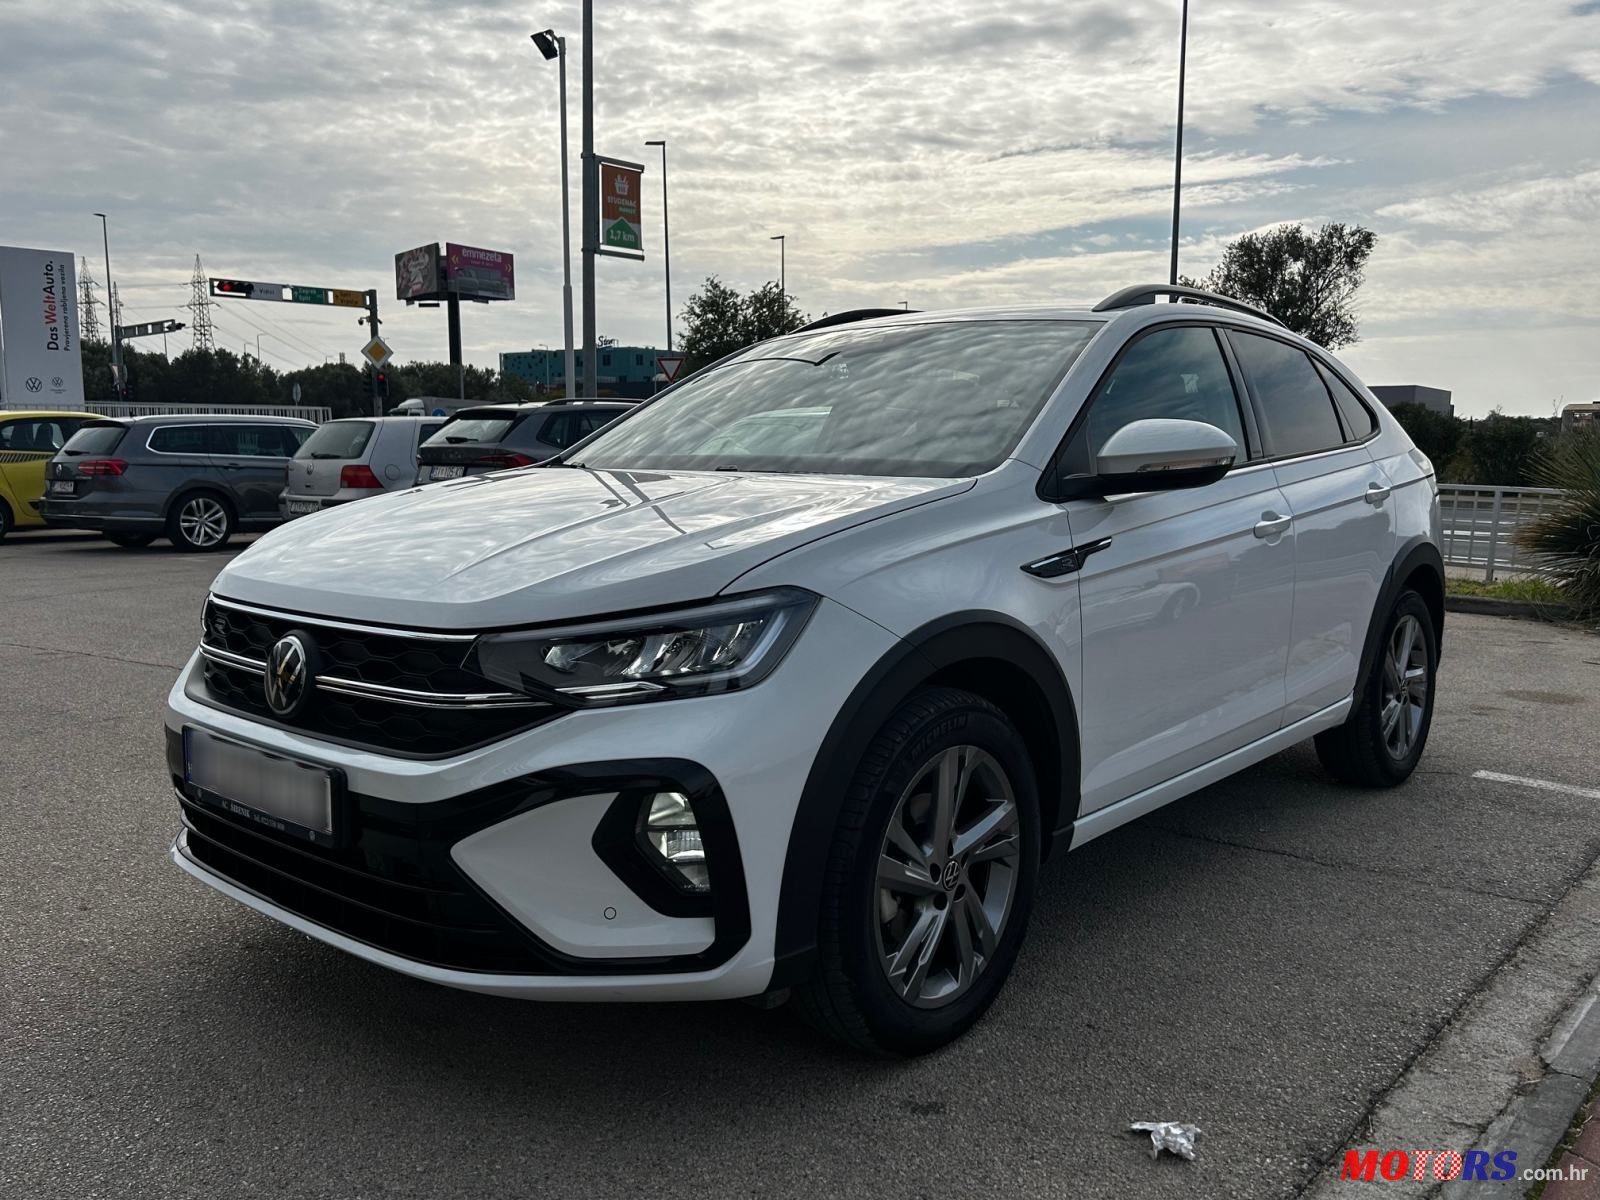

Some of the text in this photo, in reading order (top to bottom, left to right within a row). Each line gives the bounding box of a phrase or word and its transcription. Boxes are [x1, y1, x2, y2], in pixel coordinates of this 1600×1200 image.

[610, 229, 635, 242] 1,7 km
[462, 248, 502, 263] emmezeta
[43, 260, 59, 351] Das WeltAuto.
[911, 712, 969, 760] MICHELIN
